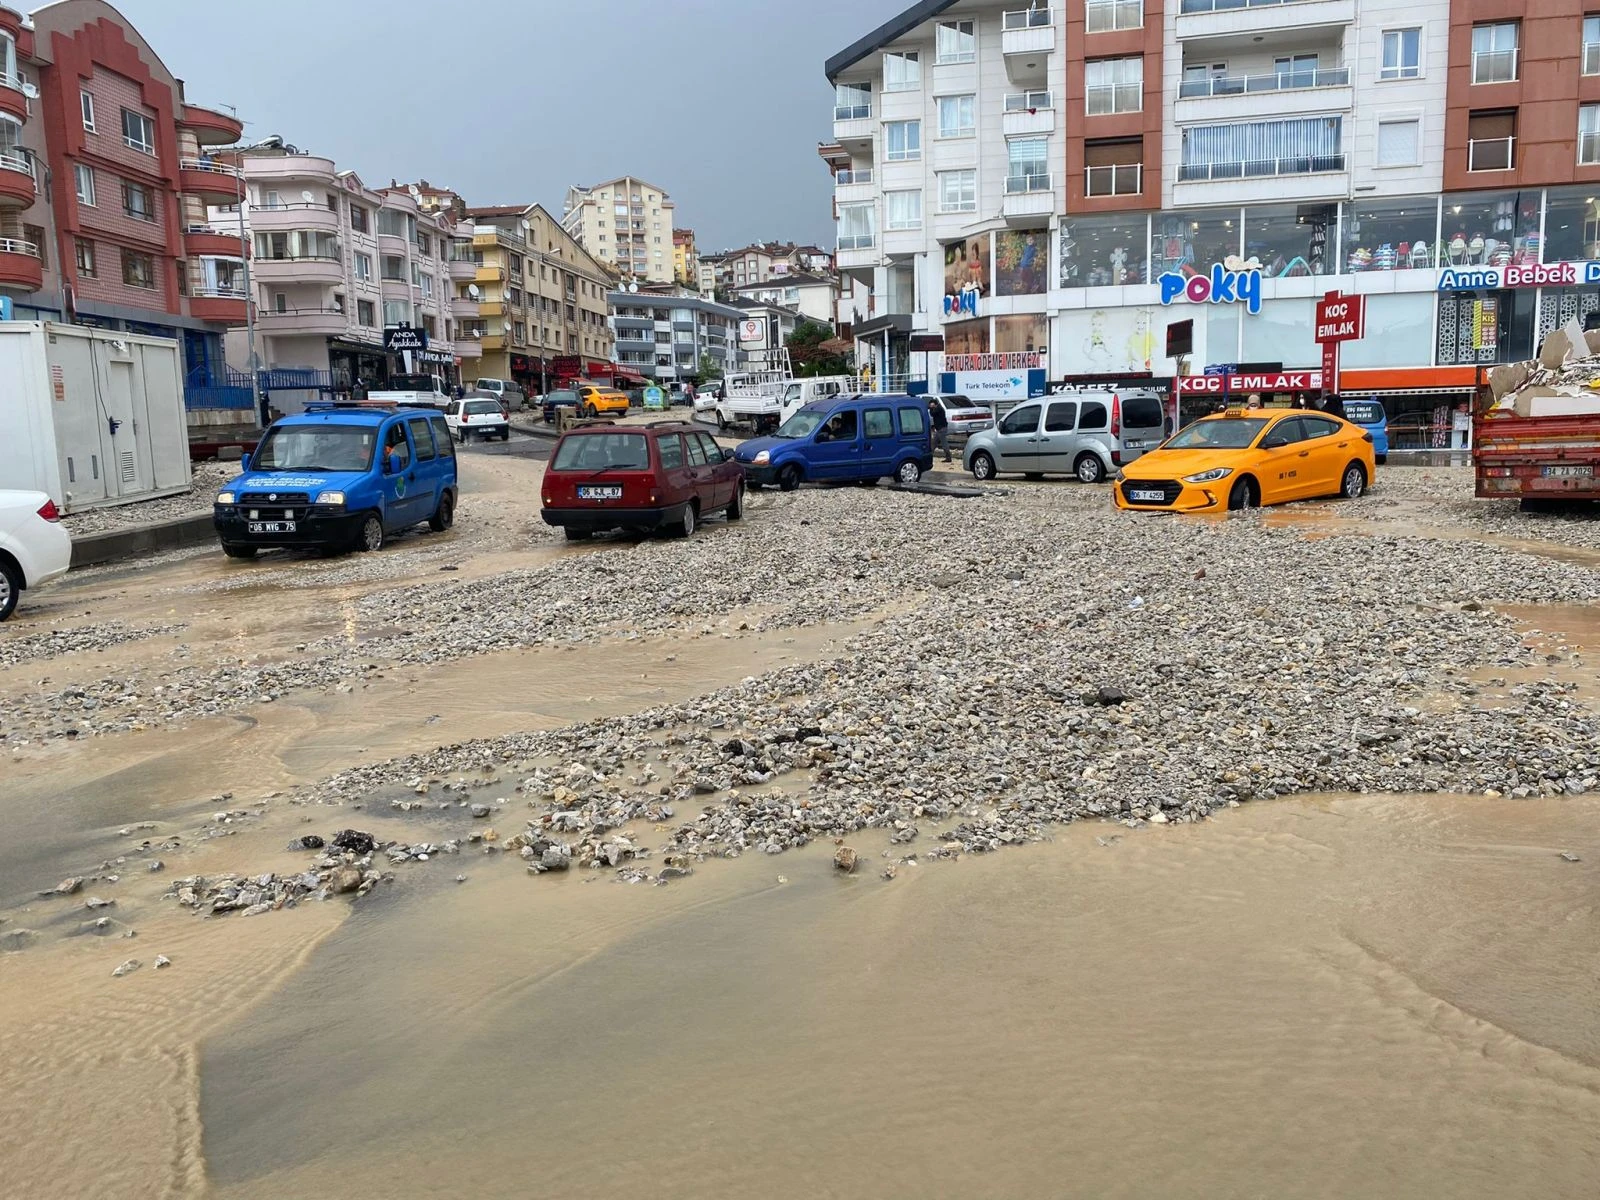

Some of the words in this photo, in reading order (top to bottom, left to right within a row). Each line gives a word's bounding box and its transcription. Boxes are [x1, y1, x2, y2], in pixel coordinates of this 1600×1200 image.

[1440, 270, 1498, 288] Anne
[1506, 263, 1576, 285] Bebek
[1325, 303, 1348, 319] KOÇ
[1318, 321, 1355, 337] EMLAK
[945, 354, 975, 372] FATURA
[965, 382, 980, 390] Türk
[982, 381, 1011, 389] Telekom
[1179, 377, 1221, 392] KOÇ
[1230, 375, 1304, 389] EMLAK
[1548, 467, 1556, 476] 34
[1561, 467, 1570, 476] ZA
[1574, 466, 1592, 475] 2029
[611, 487, 620, 496] 87
[285, 522, 295, 531] 75
